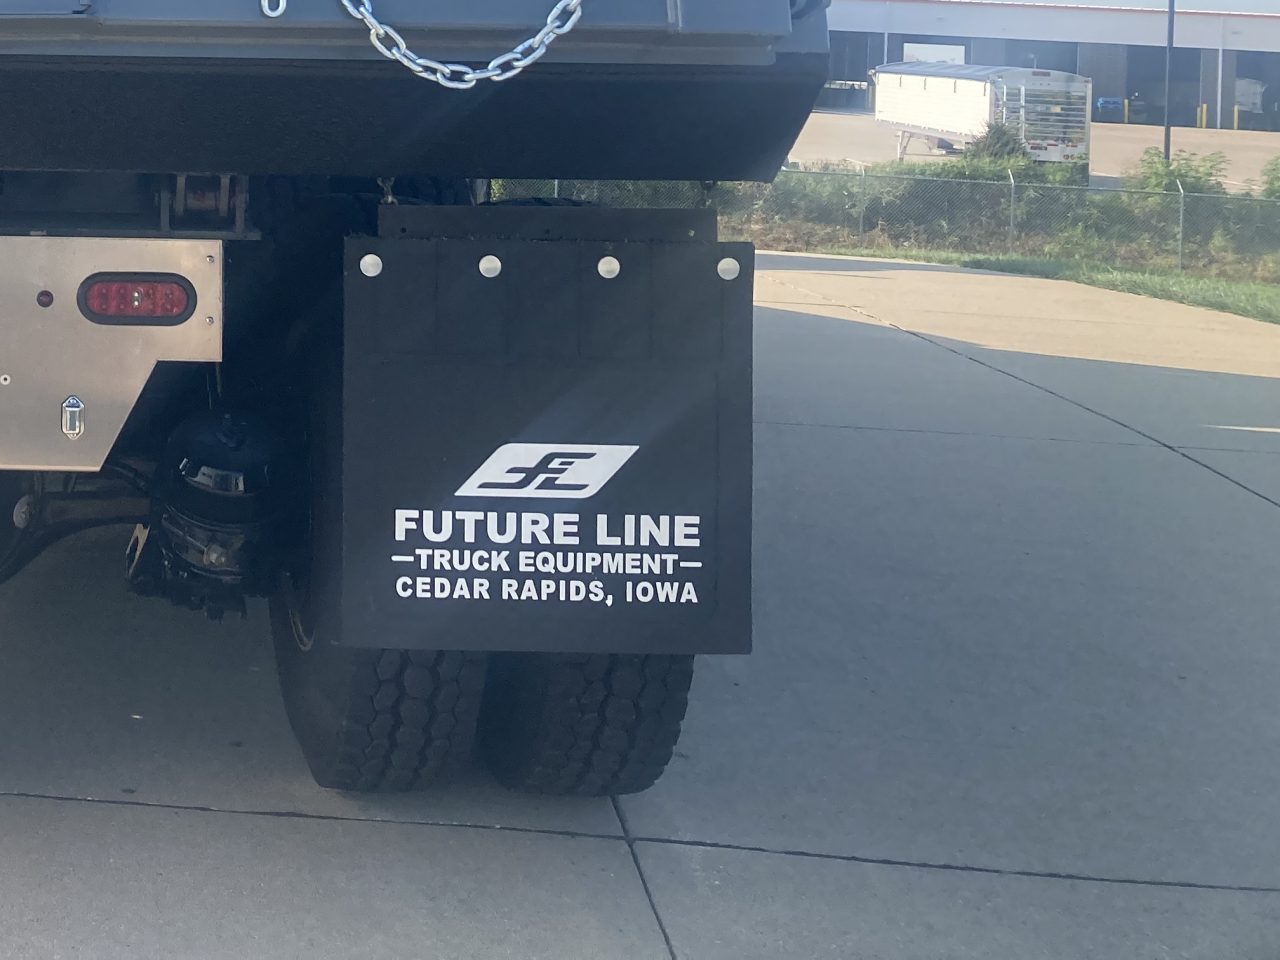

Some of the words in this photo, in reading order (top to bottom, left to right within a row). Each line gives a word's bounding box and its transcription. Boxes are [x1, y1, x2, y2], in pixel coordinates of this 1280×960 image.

[394, 509, 580, 545] FUTURE
[596, 513, 701, 547] LINE
[414, 548, 510, 572] TRUCK
[395, 576, 490, 600] CEDAR
[502, 579, 614, 607] RAPIDS,
[626, 581, 699, 604] IOWA
